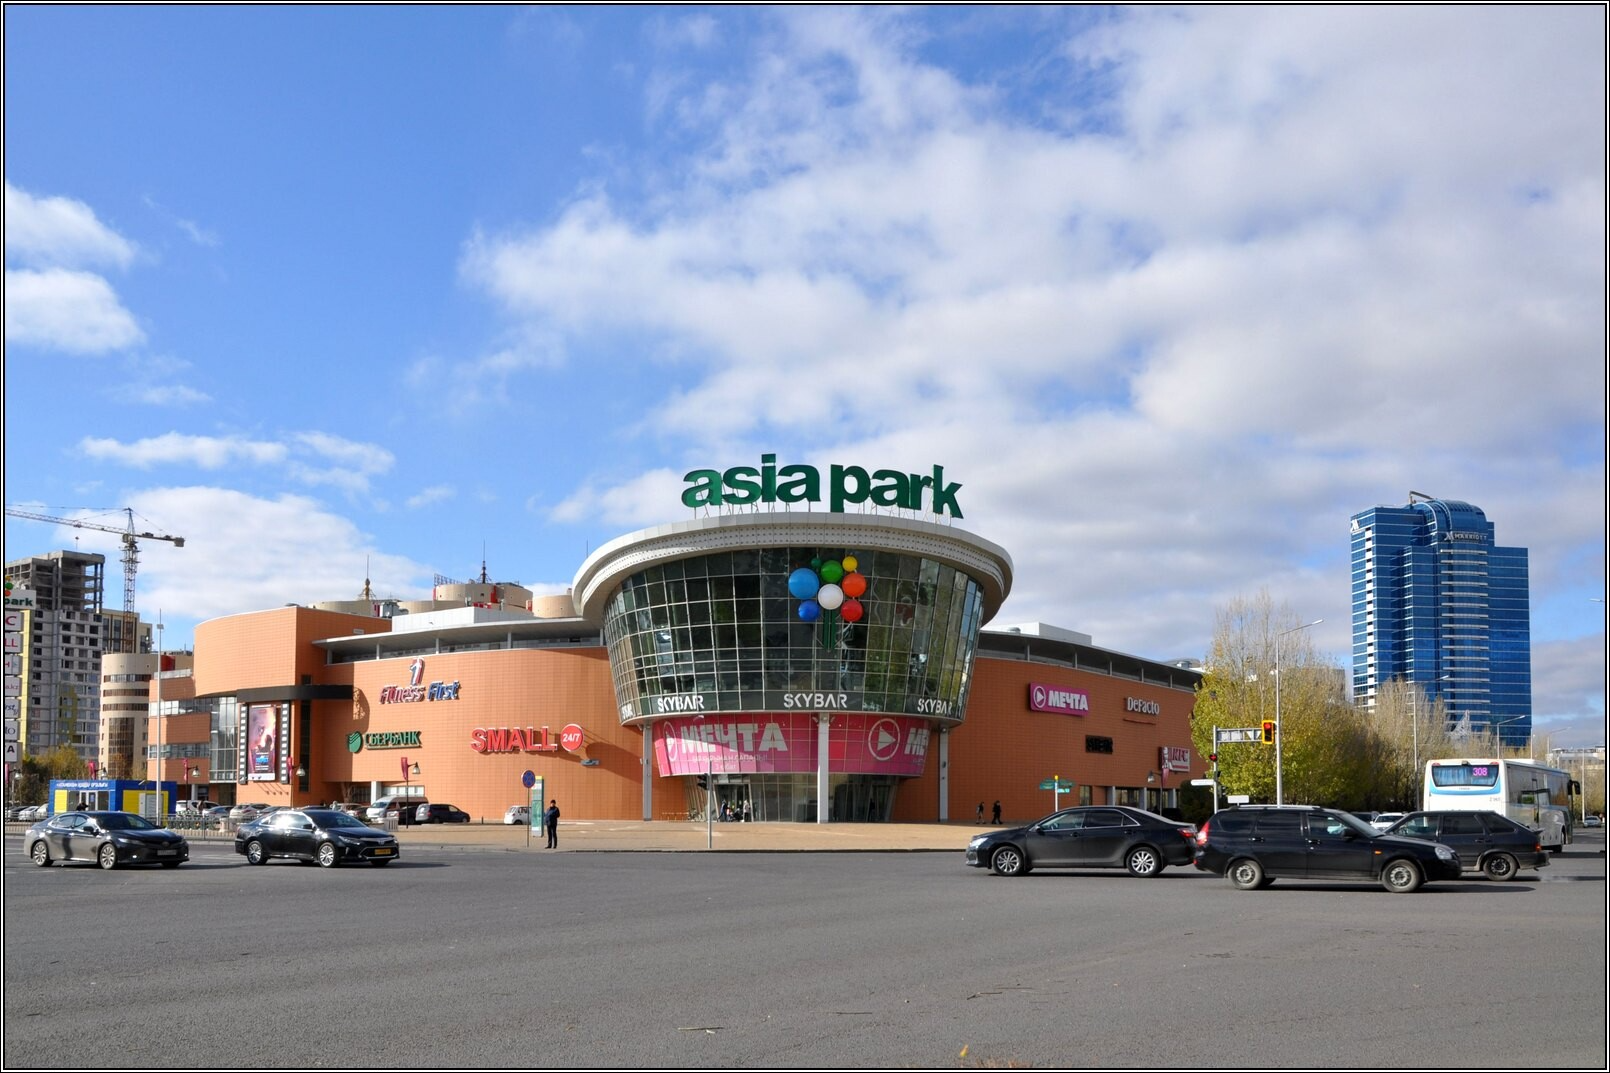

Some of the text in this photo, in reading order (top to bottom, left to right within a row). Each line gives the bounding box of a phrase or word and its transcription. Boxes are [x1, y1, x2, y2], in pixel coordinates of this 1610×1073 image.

[681, 453, 964, 519] asia park
[427, 680, 460, 702] First
[1048, 690, 1089, 711] МЕЧТА
[657, 695, 705, 713] SKYBAR
[783, 693, 848, 709] SKYBAR
[1127, 697, 1160, 715] DeFacto
[364, 731, 422, 747] СБЕРБАНК
[471, 726, 581, 752] SMALL 24/7
[681, 722, 788, 754] МЕЧТА
[1472, 767, 1488, 776] 308
